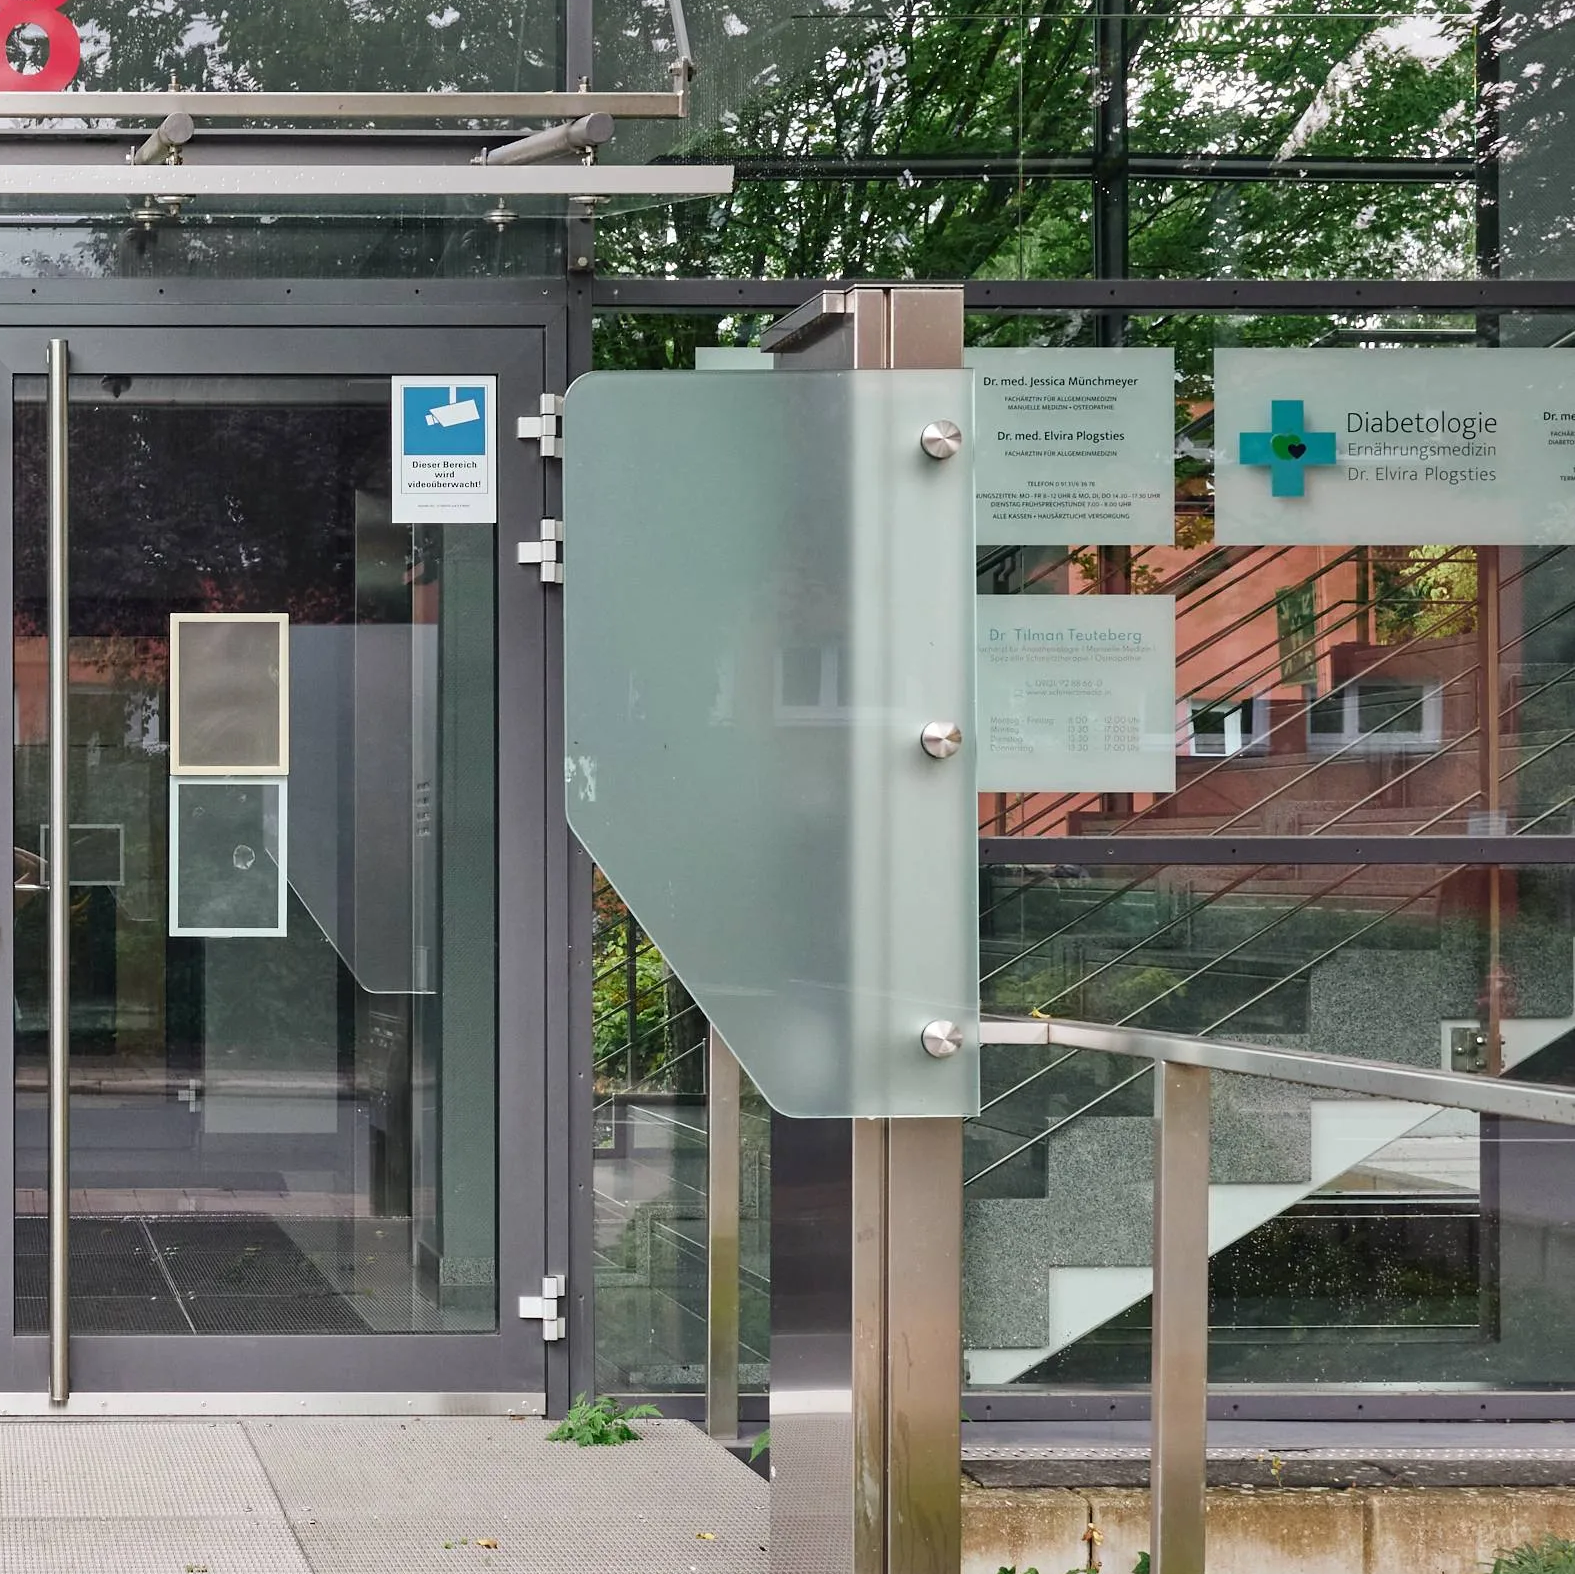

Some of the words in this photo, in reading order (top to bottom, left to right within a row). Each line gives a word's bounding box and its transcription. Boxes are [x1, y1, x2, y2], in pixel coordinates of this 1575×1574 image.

[983, 377, 998, 386] Dr.
[1001, 377, 1028, 386] med.
[1029, 376, 1065, 387] Jessica
[1068, 376, 1138, 388] Münchmeyer
[1543, 411, 1558, 421] Dr.
[1347, 411, 1497, 439] Diabetologie
[997, 431, 1012, 441] Dr.
[1015, 431, 1041, 441] med.
[1044, 431, 1074, 441] Elvira
[1076, 431, 1125, 443] Plogsties
[1348, 442, 1496, 460] Ernährungsmedizin
[412, 461, 440, 469] Dieser
[443, 461, 477, 469] Bereich
[1348, 467, 1369, 481] Dr.
[1376, 466, 1418, 481] Elvira
[1425, 466, 1497, 485] Plogsties
[407, 480, 481, 488] videoüberwacht!
[1015, 628, 1064, 642] Tilman
[1068, 628, 1142, 644] Teuteberg
